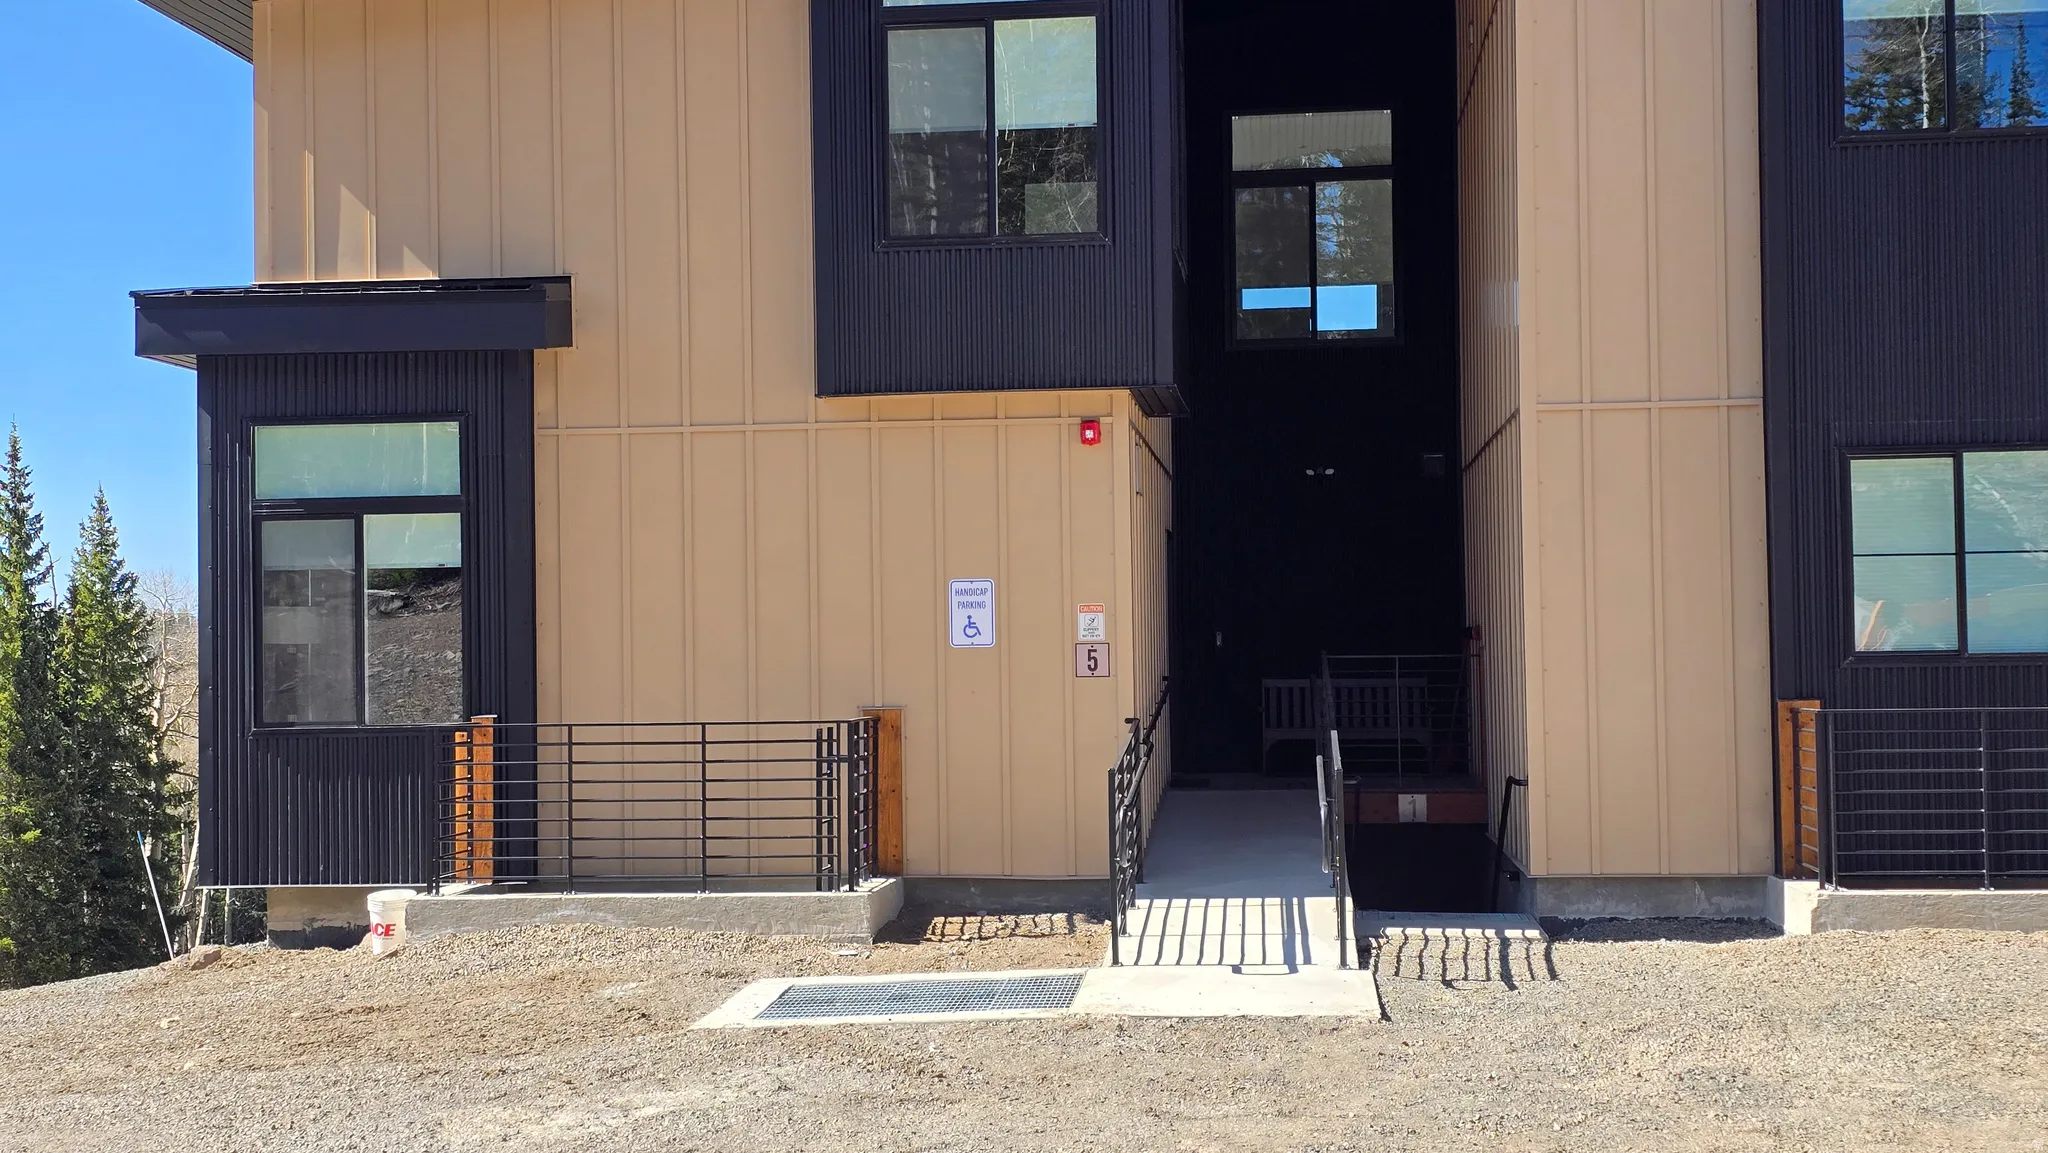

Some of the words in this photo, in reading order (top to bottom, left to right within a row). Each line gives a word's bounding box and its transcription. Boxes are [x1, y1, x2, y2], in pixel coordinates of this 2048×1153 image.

[955, 587, 988, 596] HANDICAP
[957, 600, 986, 609] PARKING
[1087, 648, 1098, 672] 5
[1408, 798, 1416, 819] 1
